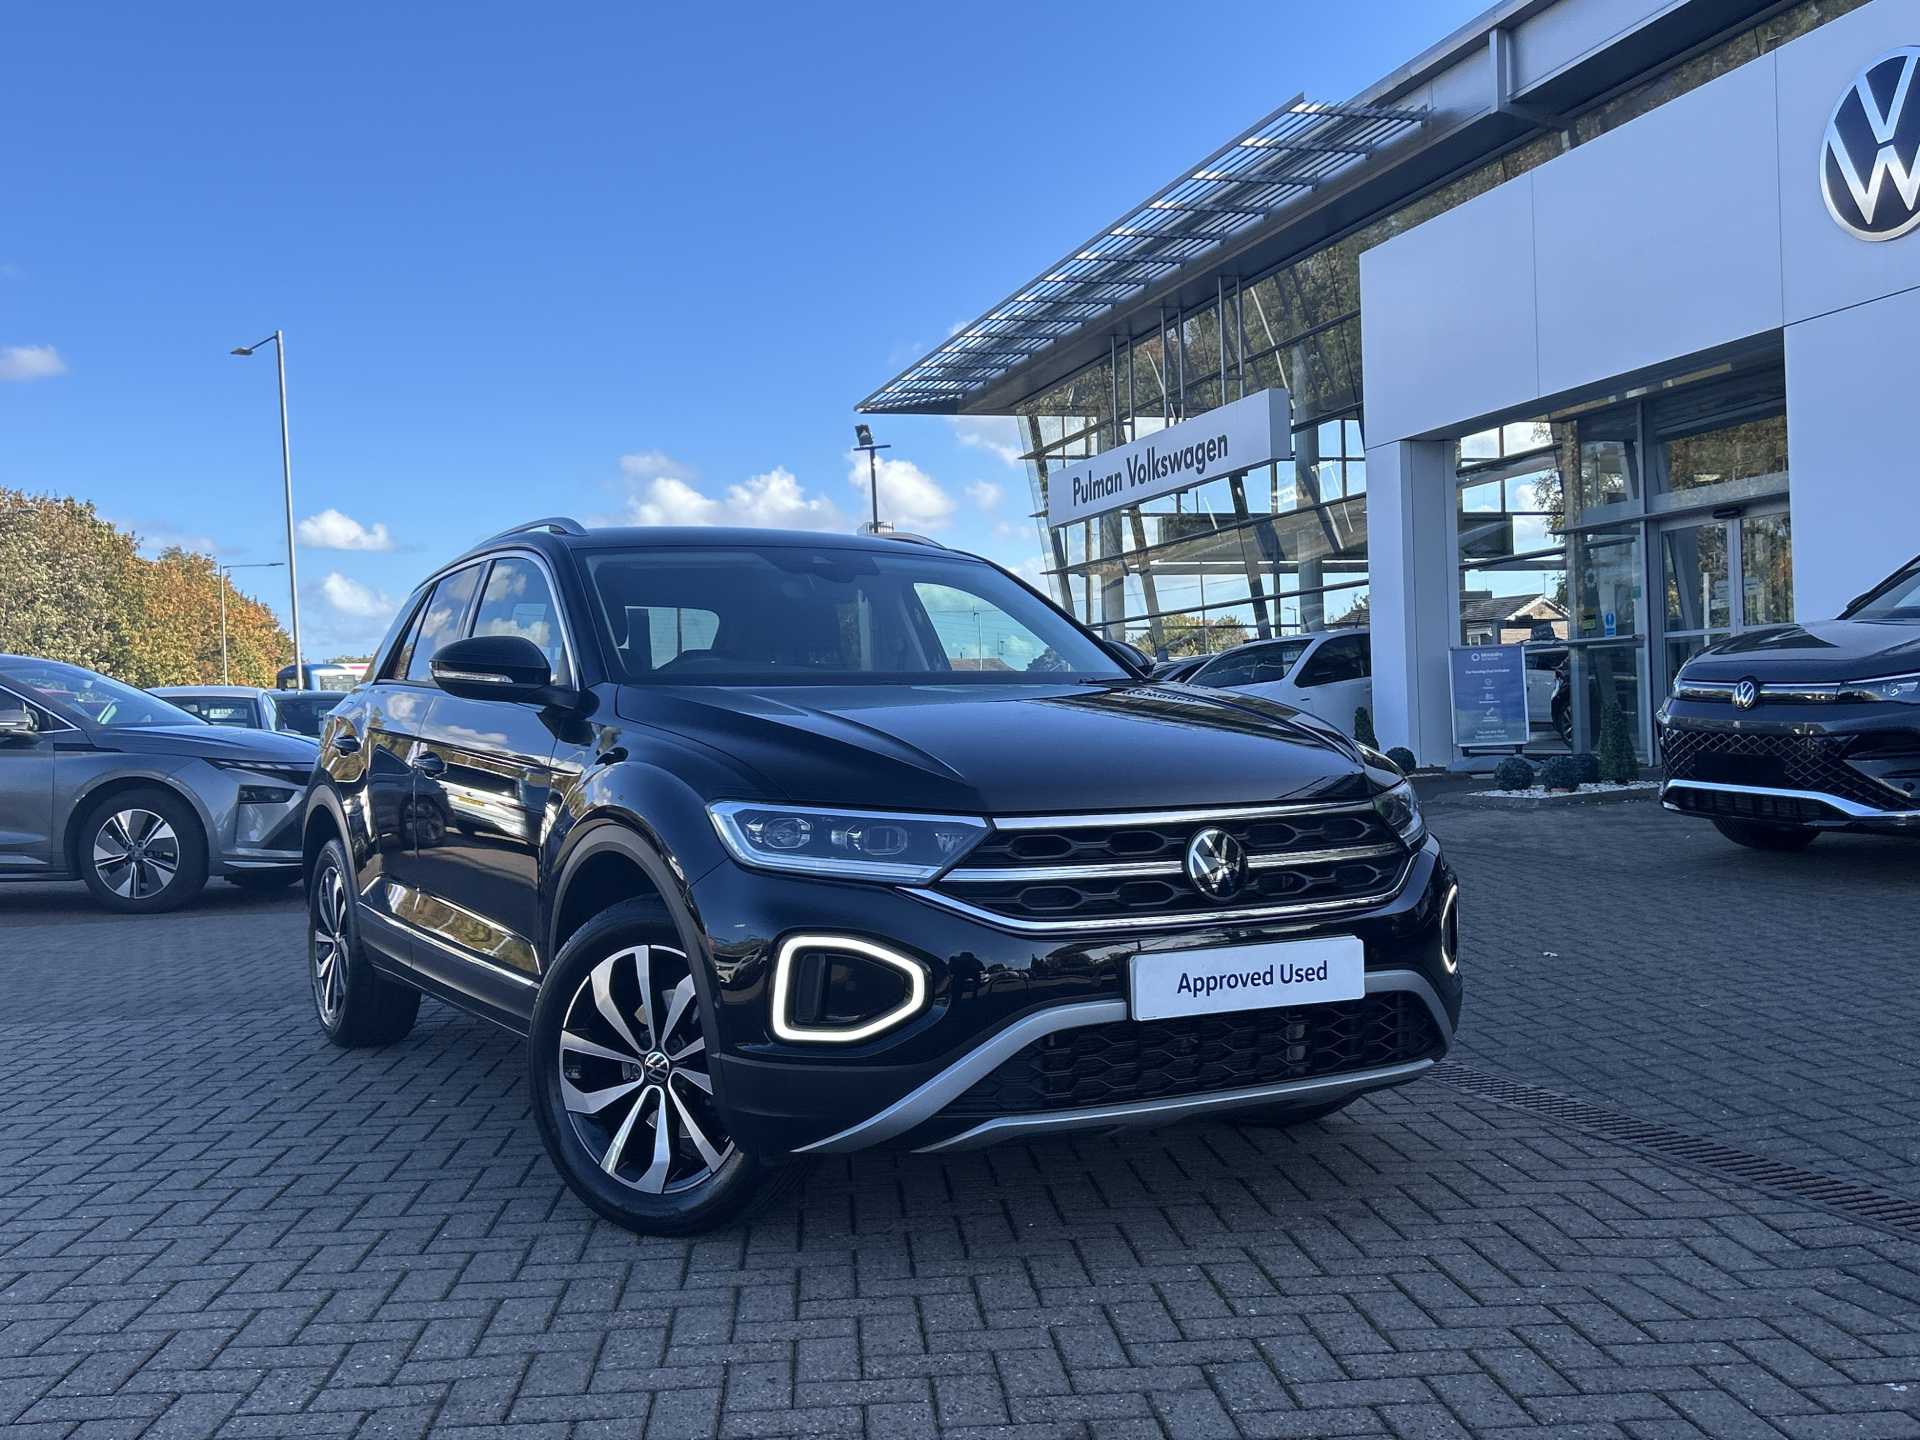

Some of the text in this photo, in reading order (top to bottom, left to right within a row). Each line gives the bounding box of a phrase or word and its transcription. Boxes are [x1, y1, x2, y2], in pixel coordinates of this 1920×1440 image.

[1821, 48, 1920, 240] VW
[1072, 434, 1229, 507] Pulman Volkswagen
[1176, 960, 1328, 998] Approved Used
